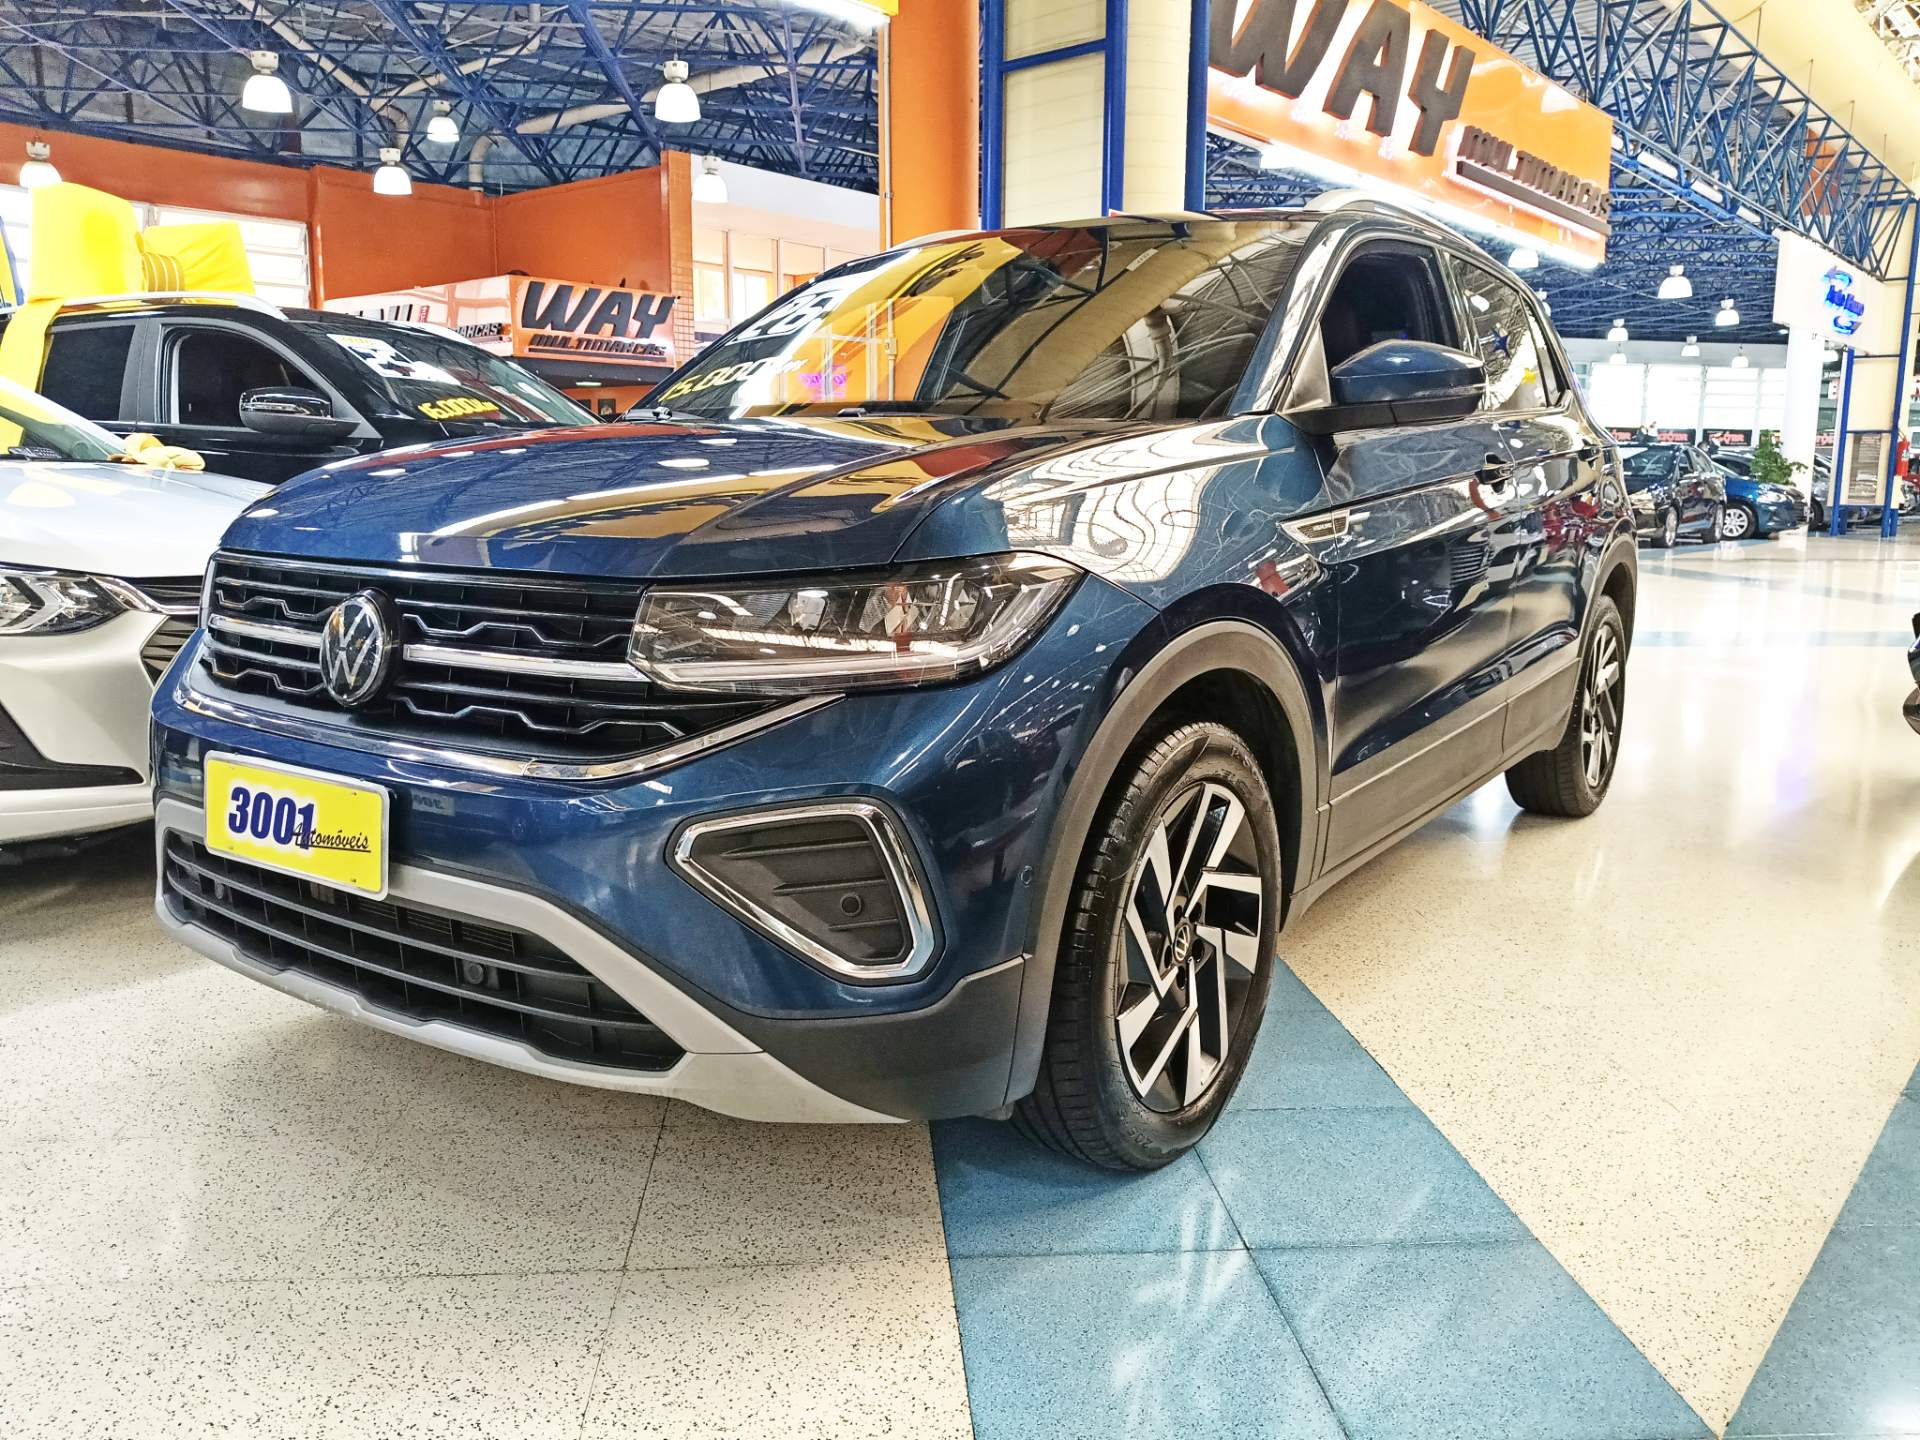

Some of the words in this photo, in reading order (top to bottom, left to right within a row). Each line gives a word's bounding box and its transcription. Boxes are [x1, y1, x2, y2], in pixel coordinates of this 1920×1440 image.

[1208, 0, 1475, 156] WAY
[1457, 125, 1612, 219] MULTIMARCAS
[521, 281, 675, 339] WAY
[529, 334, 667, 356] MULTIMARCAS
[228, 786, 316, 850] 3001
[292, 822, 370, 851] Automóveis
